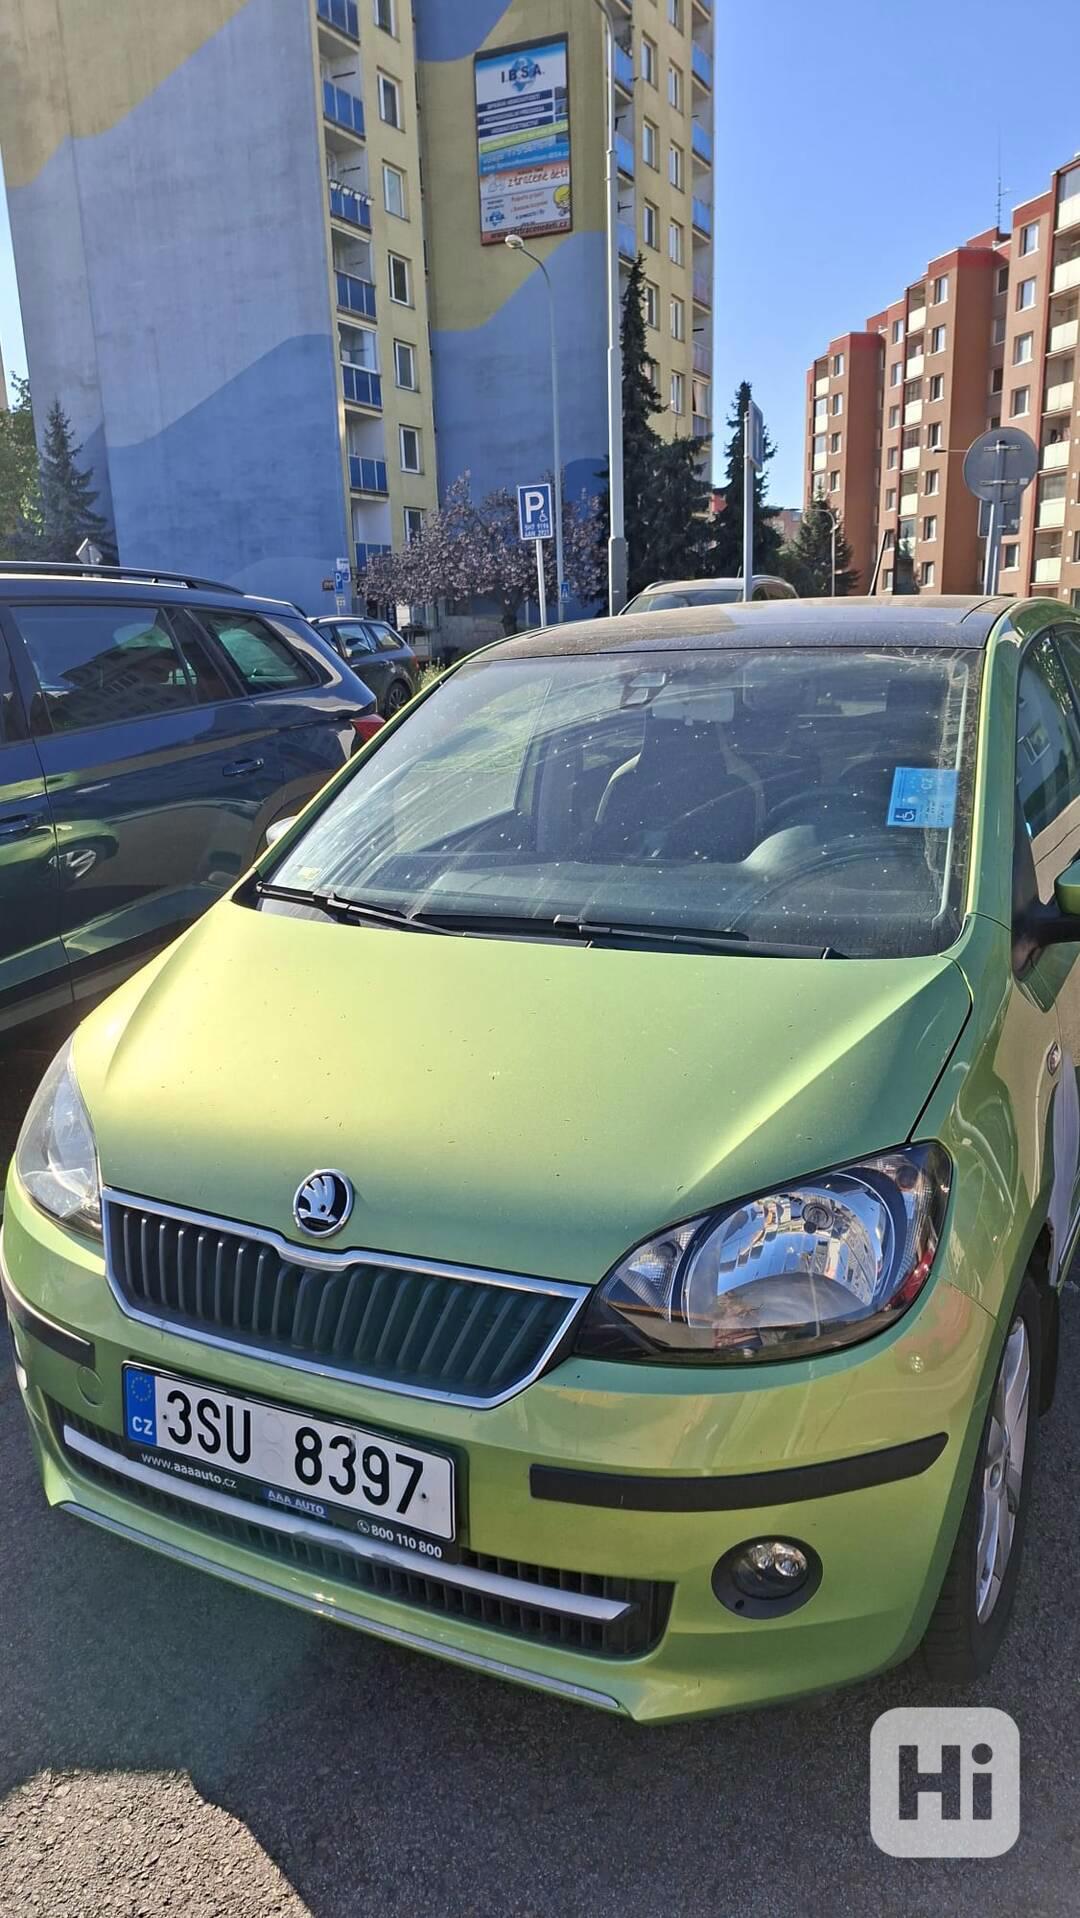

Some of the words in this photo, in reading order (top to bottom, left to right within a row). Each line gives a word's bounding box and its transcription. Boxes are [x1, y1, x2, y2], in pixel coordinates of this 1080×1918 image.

[525, 492, 544, 523] P
[335, 572, 342, 588] P
[132, 1415, 153, 1436] CZ
[167, 1390, 251, 1464] 3SU
[294, 1426, 424, 1515] 8397
[141, 1451, 237, 1489] www.aaaauto.cz
[267, 1489, 291, 1505] AAA
[294, 1498, 325, 1516] AUTO
[371, 1524, 394, 1542] 800
[396, 1533, 417, 1549] 110
[418, 1541, 443, 1560] 800
